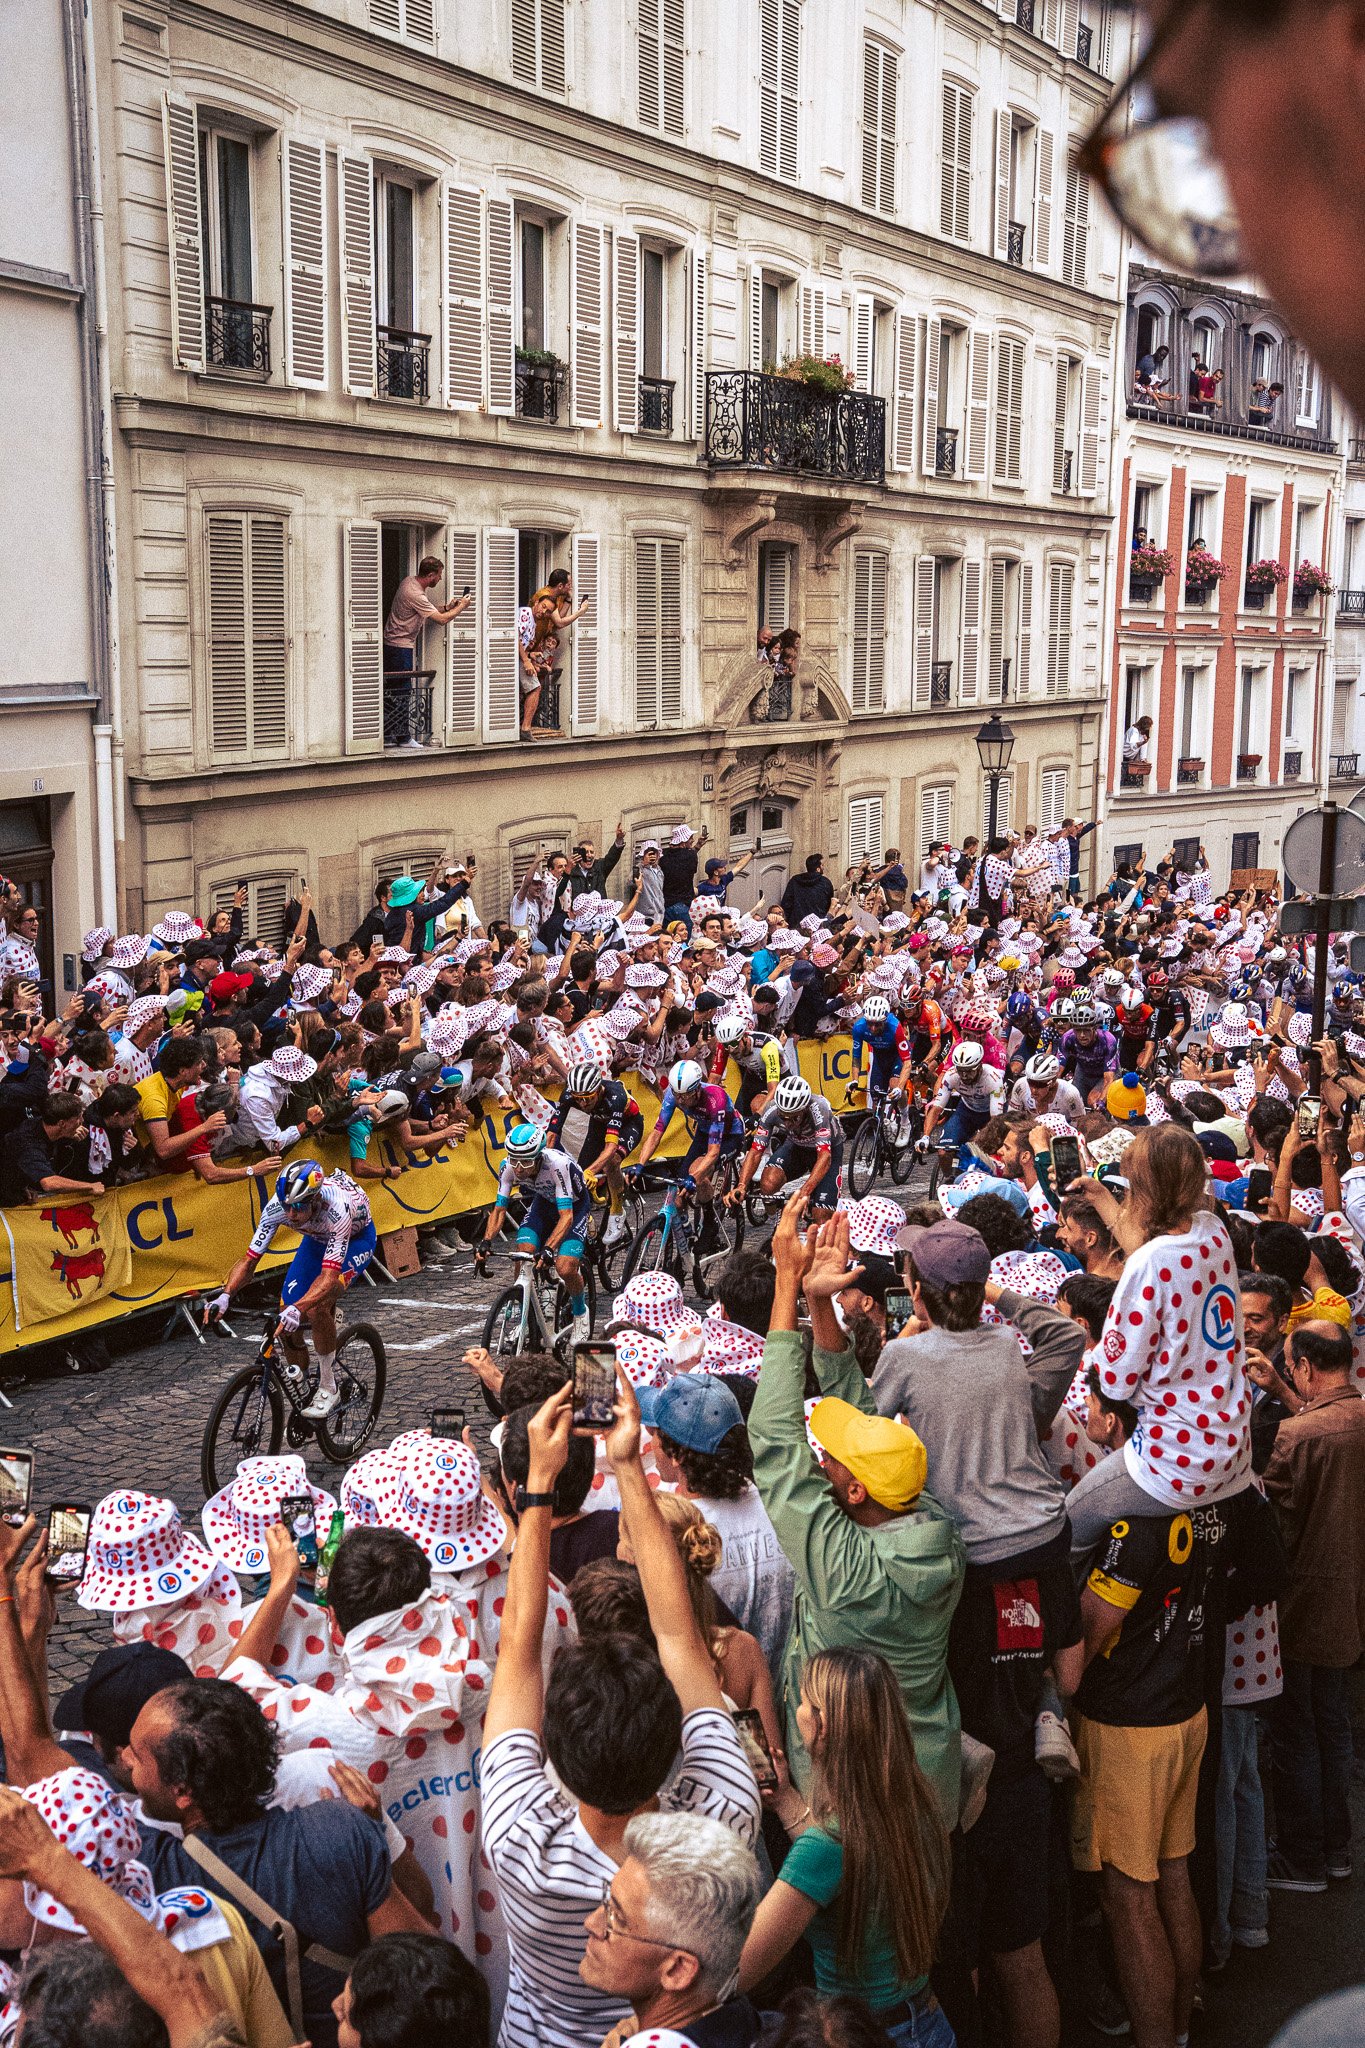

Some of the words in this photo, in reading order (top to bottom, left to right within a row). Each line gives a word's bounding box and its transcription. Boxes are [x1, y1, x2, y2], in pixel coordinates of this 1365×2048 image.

[822, 1050, 868, 1081] LC
[127, 1197, 194, 1252] CL
[254, 1223, 271, 1247] BOSS
[326, 1231, 337, 1254] BOSS
[340, 1235, 349, 1258] BORA
[352, 1249, 374, 1267] BORA
